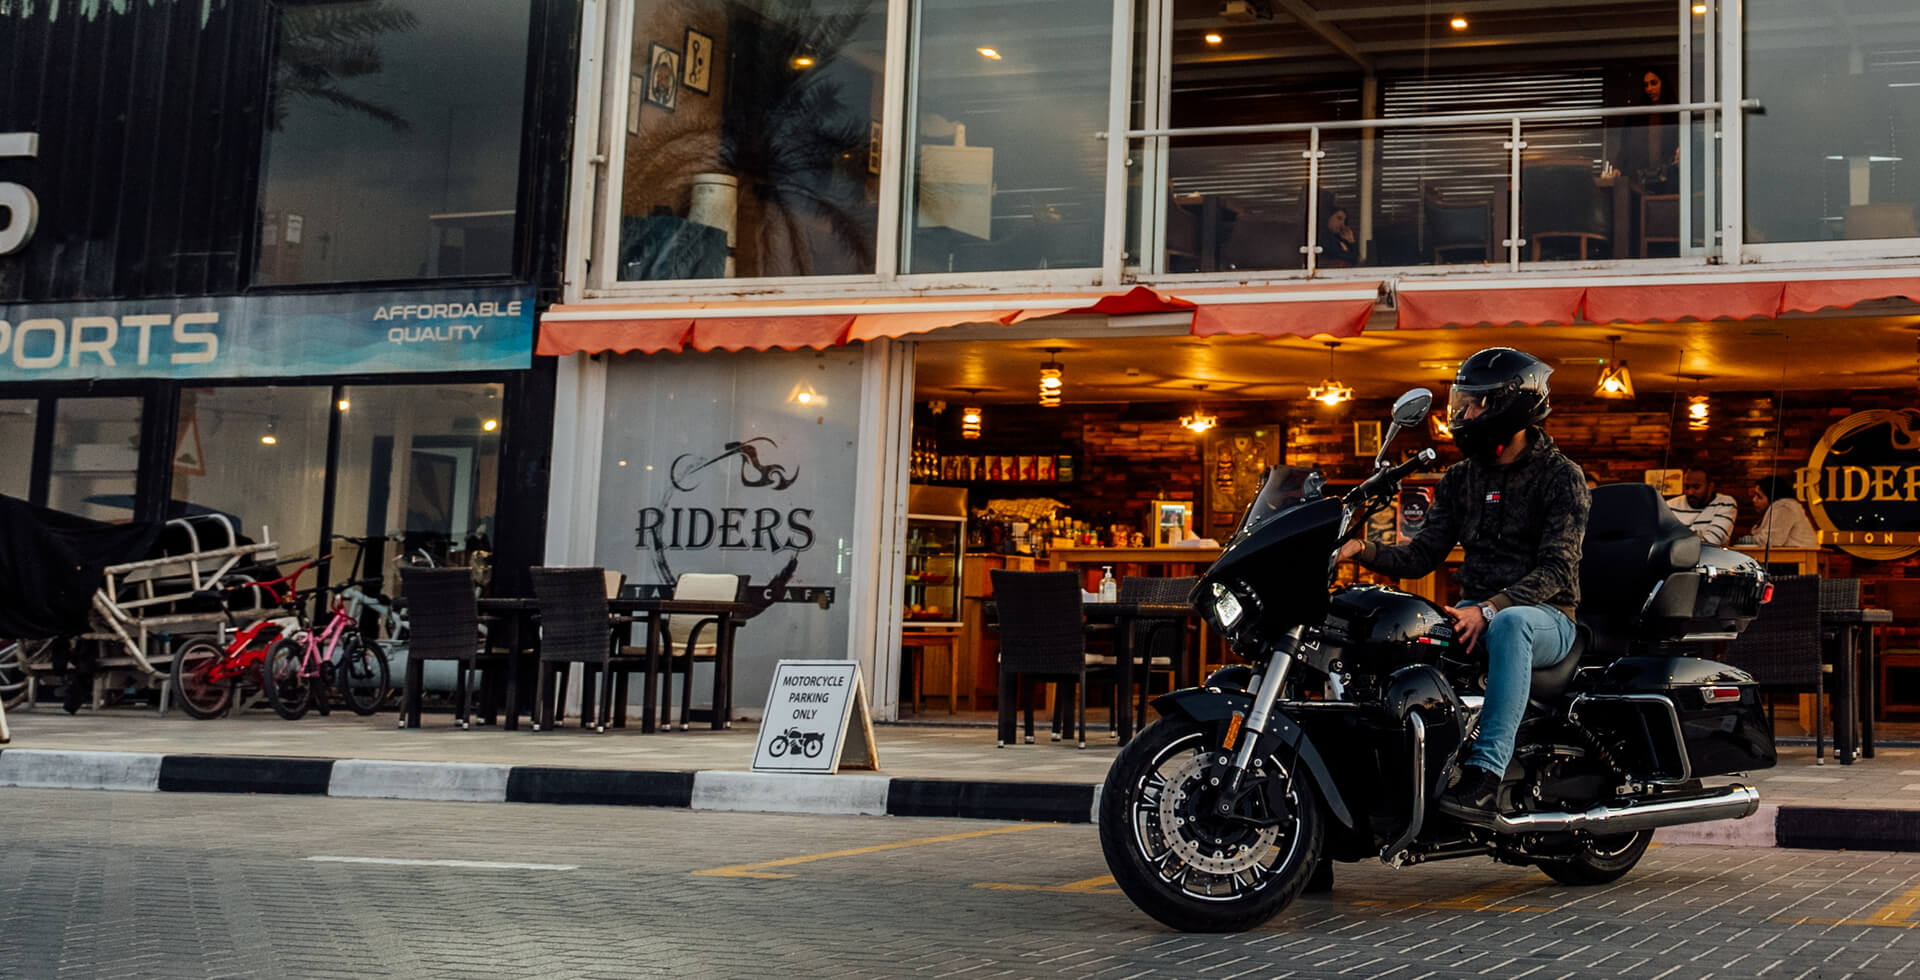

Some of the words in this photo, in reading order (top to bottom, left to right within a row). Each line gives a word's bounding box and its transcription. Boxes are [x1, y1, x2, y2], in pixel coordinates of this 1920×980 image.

[373, 301, 522, 321] AFFORDABLE
[0, 311, 219, 369] ORTS
[388, 325, 483, 345] QUALITY
[635, 506, 816, 552] RIDERS
[783, 676, 844, 687] MOTORCYCLE
[789, 692, 829, 703] PARKING
[792, 709, 817, 720] ONLY
